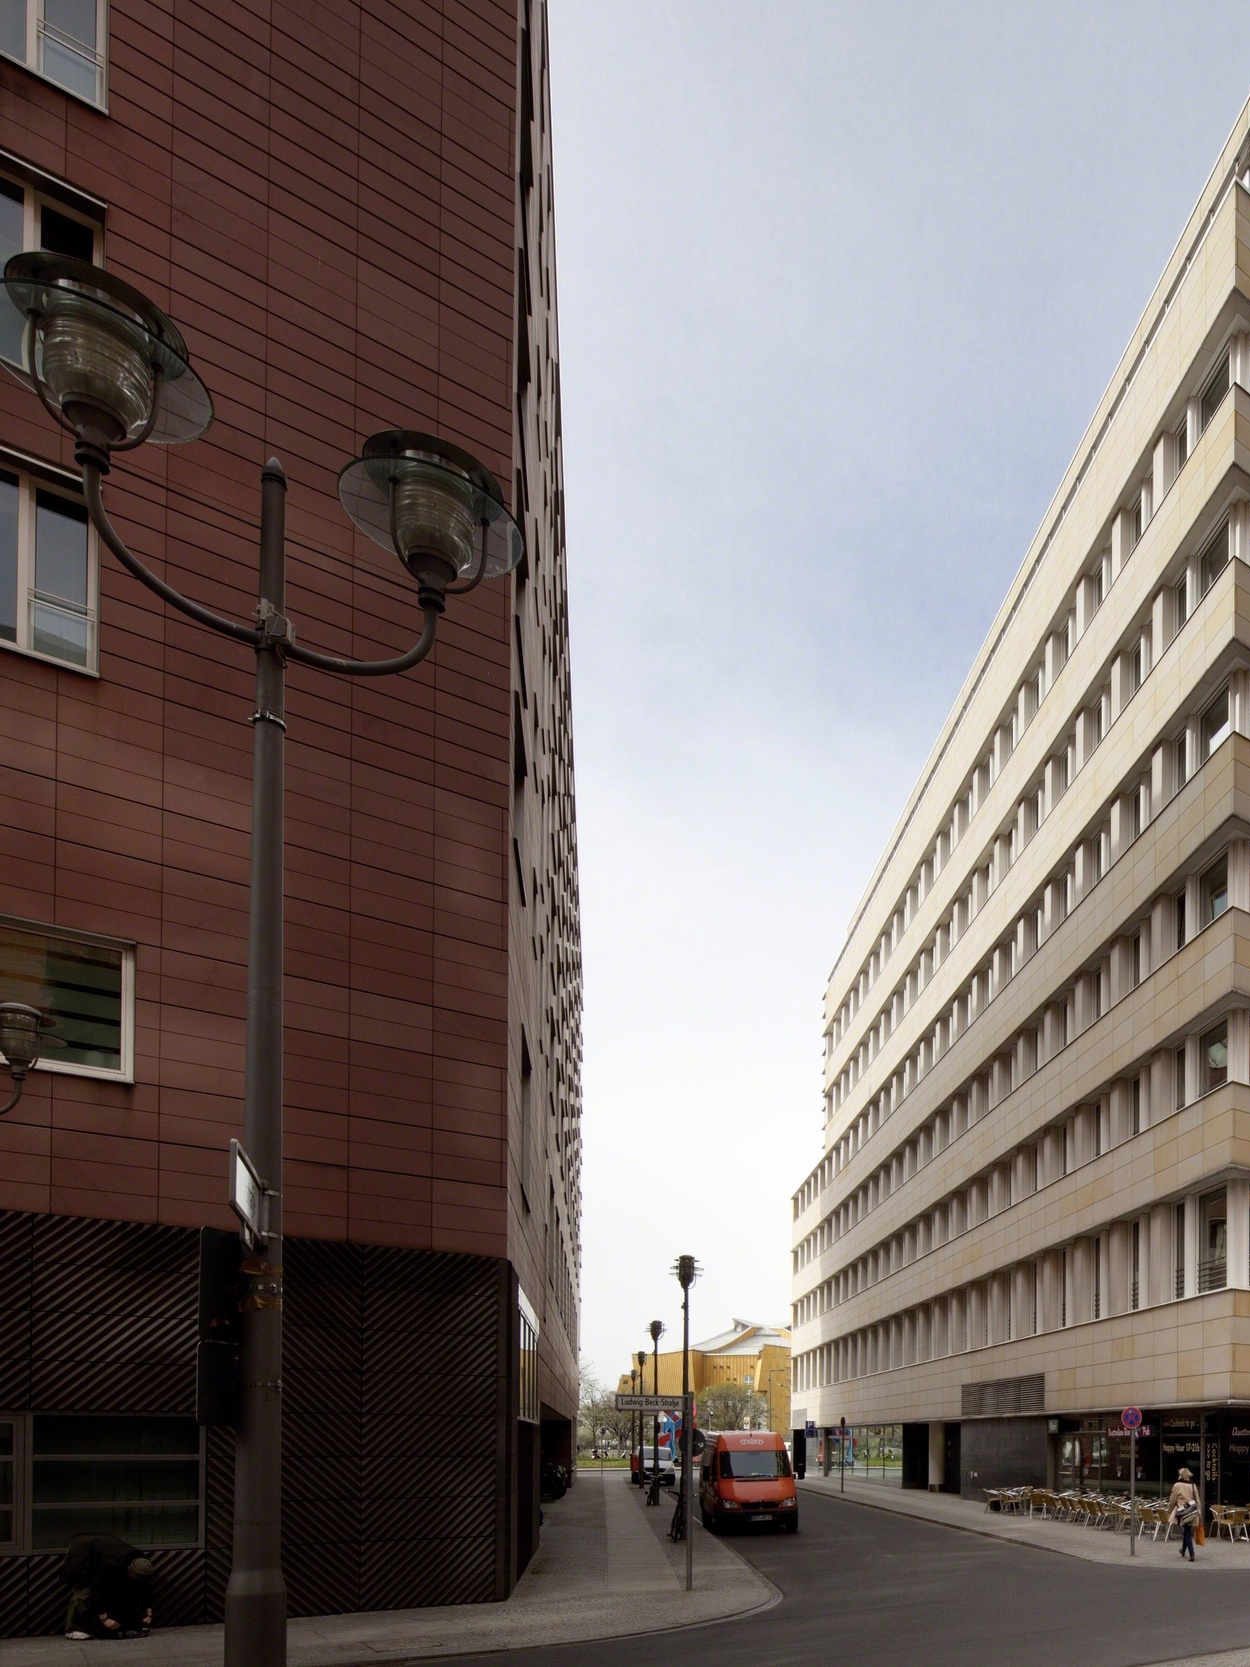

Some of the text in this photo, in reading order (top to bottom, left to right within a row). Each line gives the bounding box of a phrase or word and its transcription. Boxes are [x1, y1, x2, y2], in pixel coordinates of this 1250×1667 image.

[1229, 1443, 1250, 1454] Happy
[1204, 1461, 1212, 1481] to go
